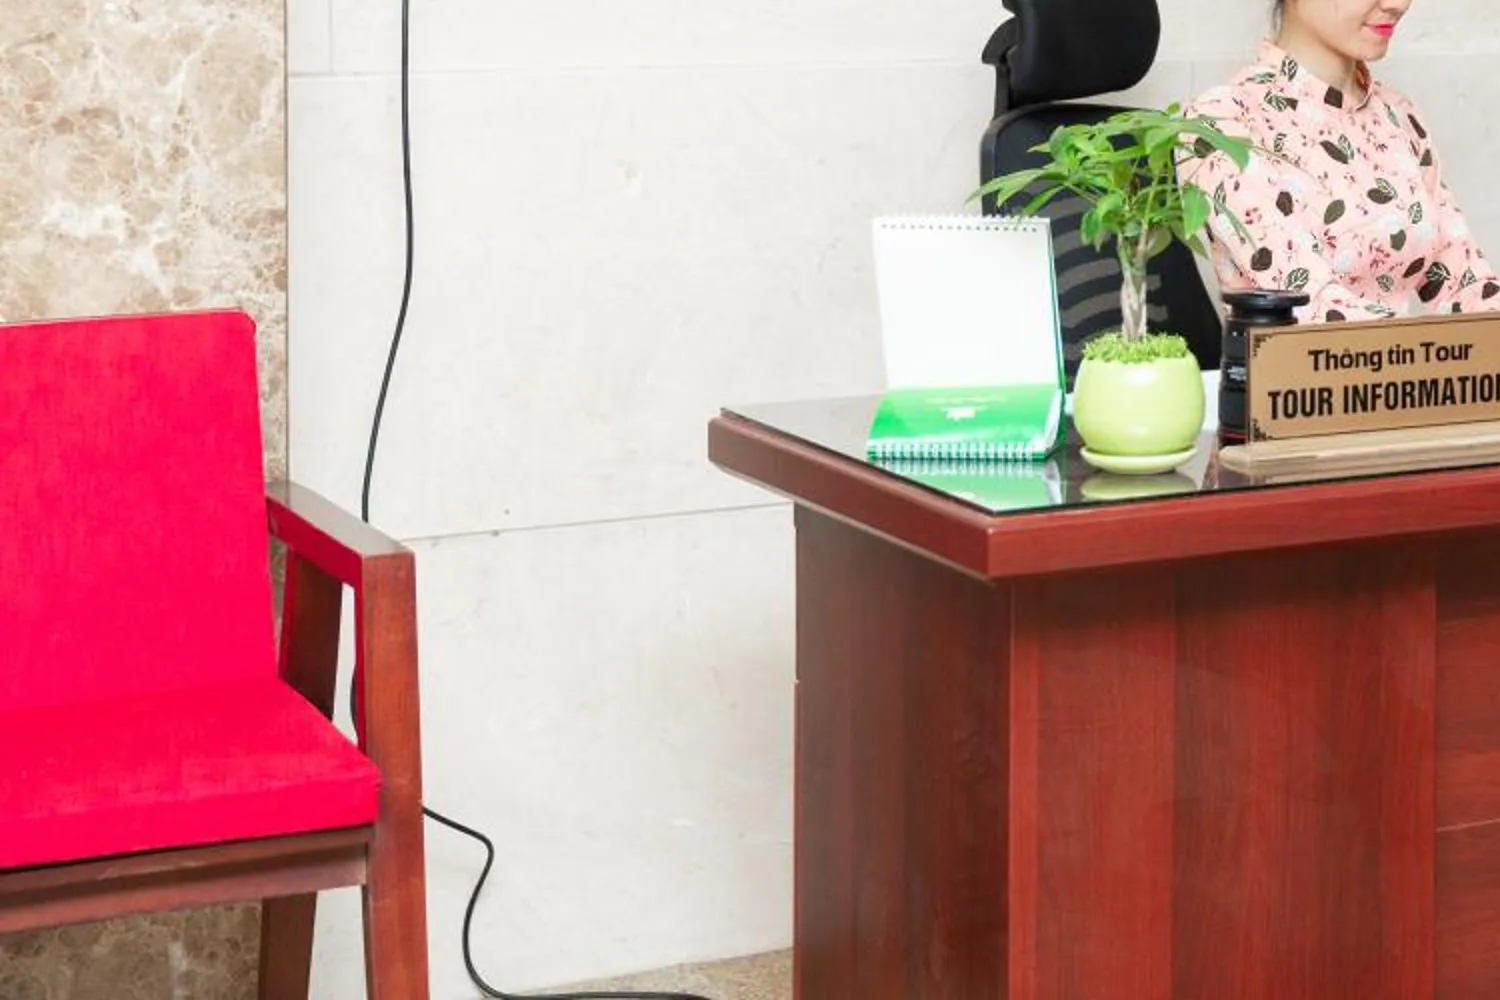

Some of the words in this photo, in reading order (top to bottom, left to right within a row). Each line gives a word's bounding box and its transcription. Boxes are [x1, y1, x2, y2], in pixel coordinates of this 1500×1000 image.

[1308, 347, 1383, 373] Thông
[1388, 344, 1415, 366] tin
[1420, 341, 1473, 364] Tour
[1268, 386, 1333, 420] TOUR
